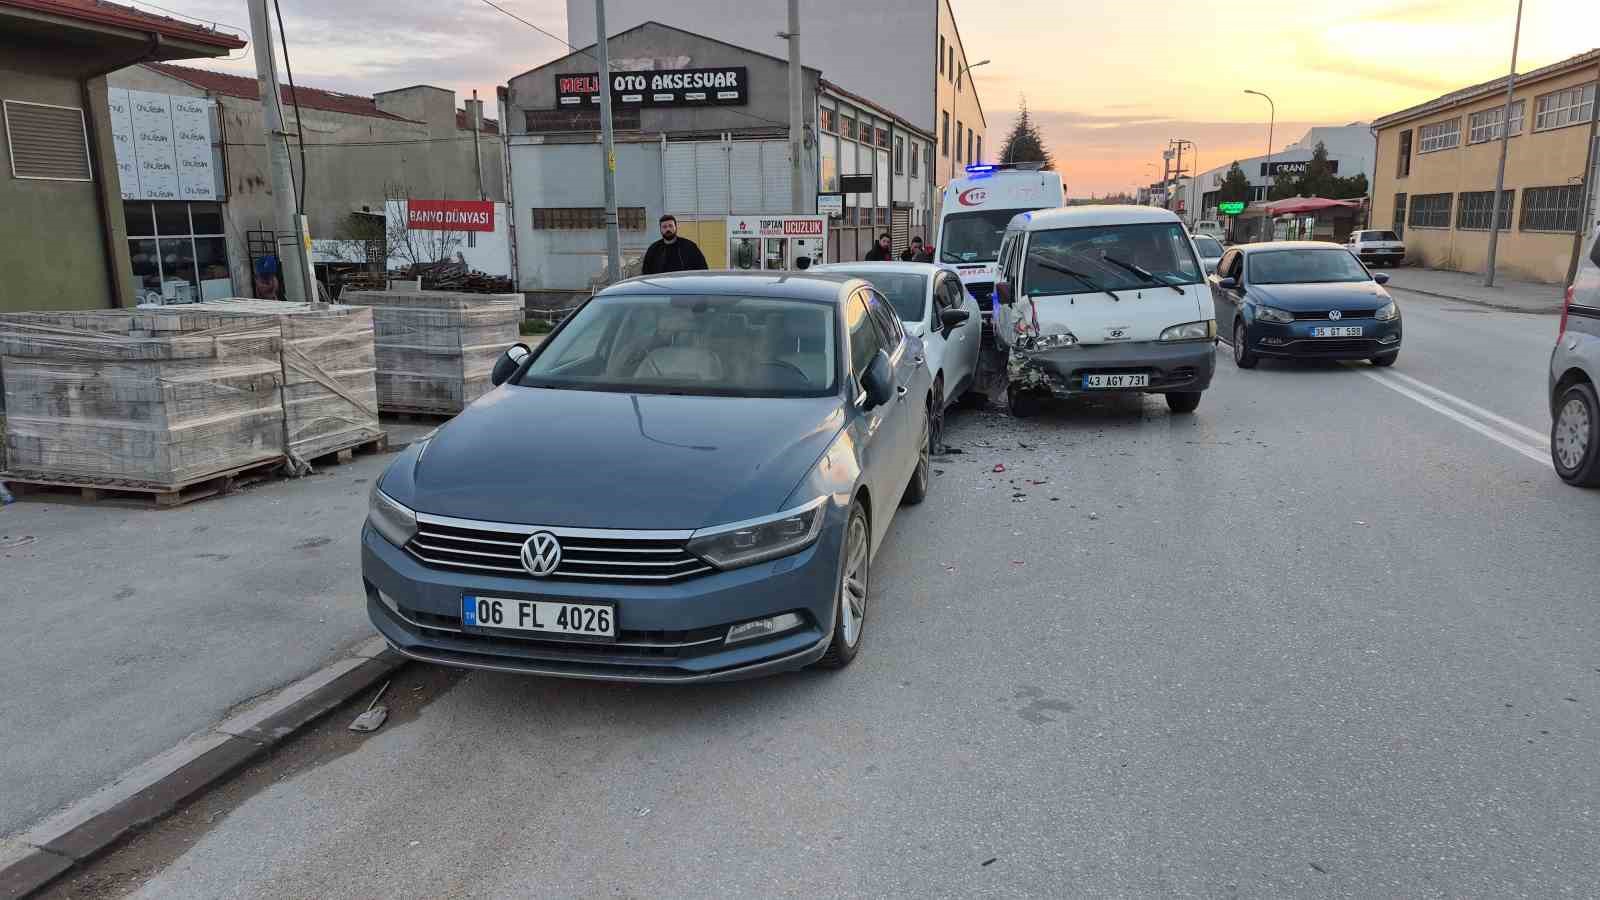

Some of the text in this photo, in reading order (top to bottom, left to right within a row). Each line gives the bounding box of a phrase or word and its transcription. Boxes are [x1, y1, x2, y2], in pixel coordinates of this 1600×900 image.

[613, 76, 647, 91] OTO
[651, 71, 738, 90] AKSESUAR
[970, 191, 986, 200] 112
[409, 208, 489, 224] BANYO DÜNYASI
[760, 219, 822, 234] TOPTAN UCUZLUK
[1088, 375, 1145, 386] 43 AGY 731
[478, 600, 503, 625] 06
[518, 603, 544, 628] FL
[557, 605, 610, 633] 4026
